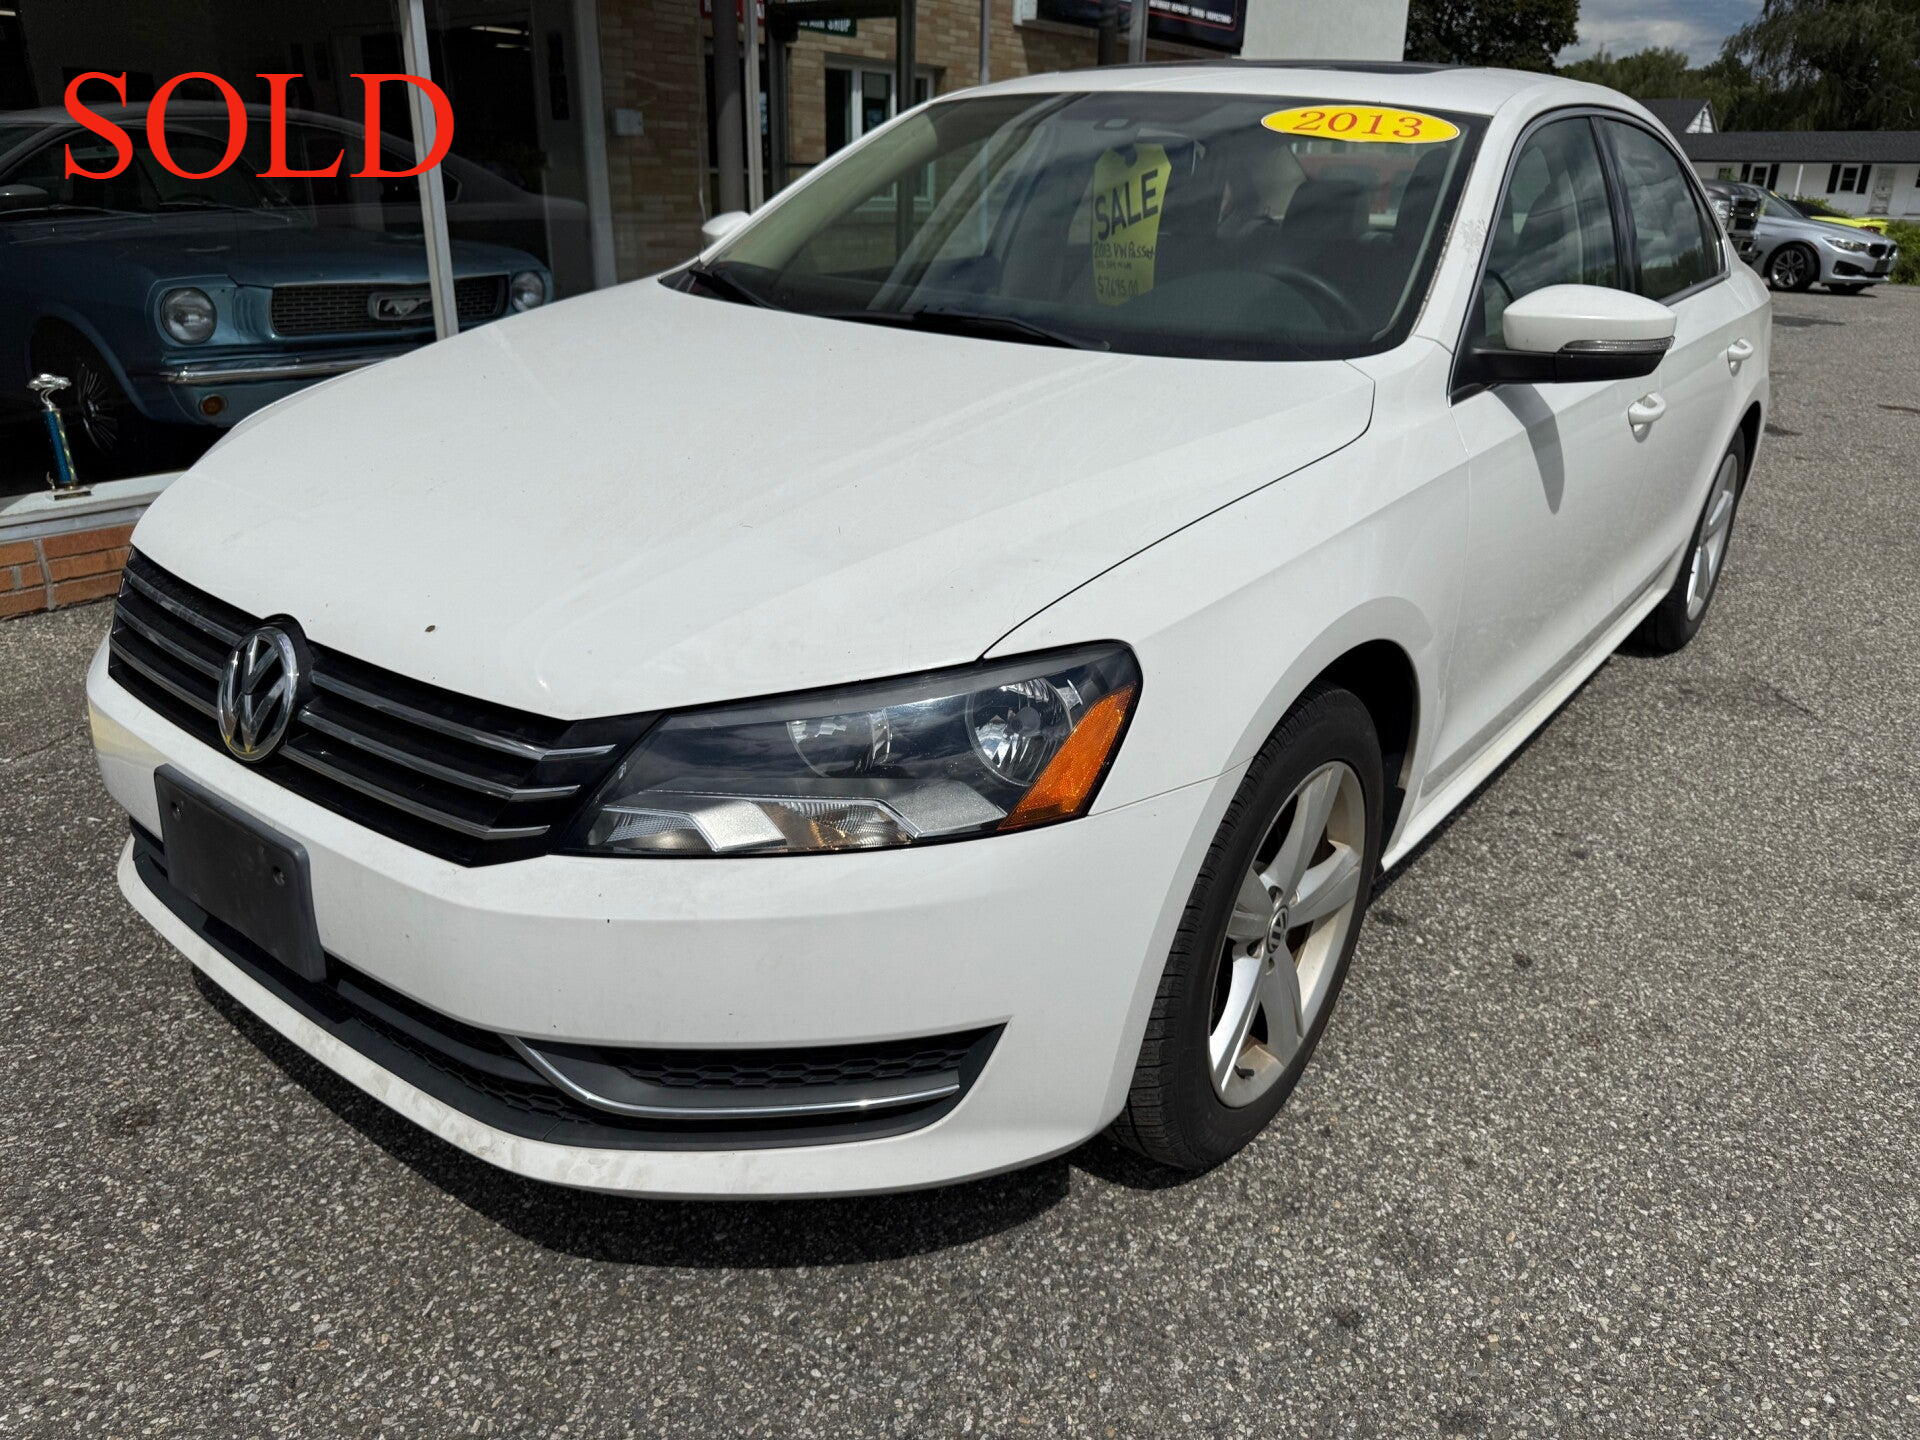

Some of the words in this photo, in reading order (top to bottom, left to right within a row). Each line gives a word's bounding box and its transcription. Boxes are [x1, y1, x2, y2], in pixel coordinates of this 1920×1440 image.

[1292, 111, 1423, 138] 2013
[1094, 168, 1159, 241] SALE
[1113, 242, 1129, 258] VW
